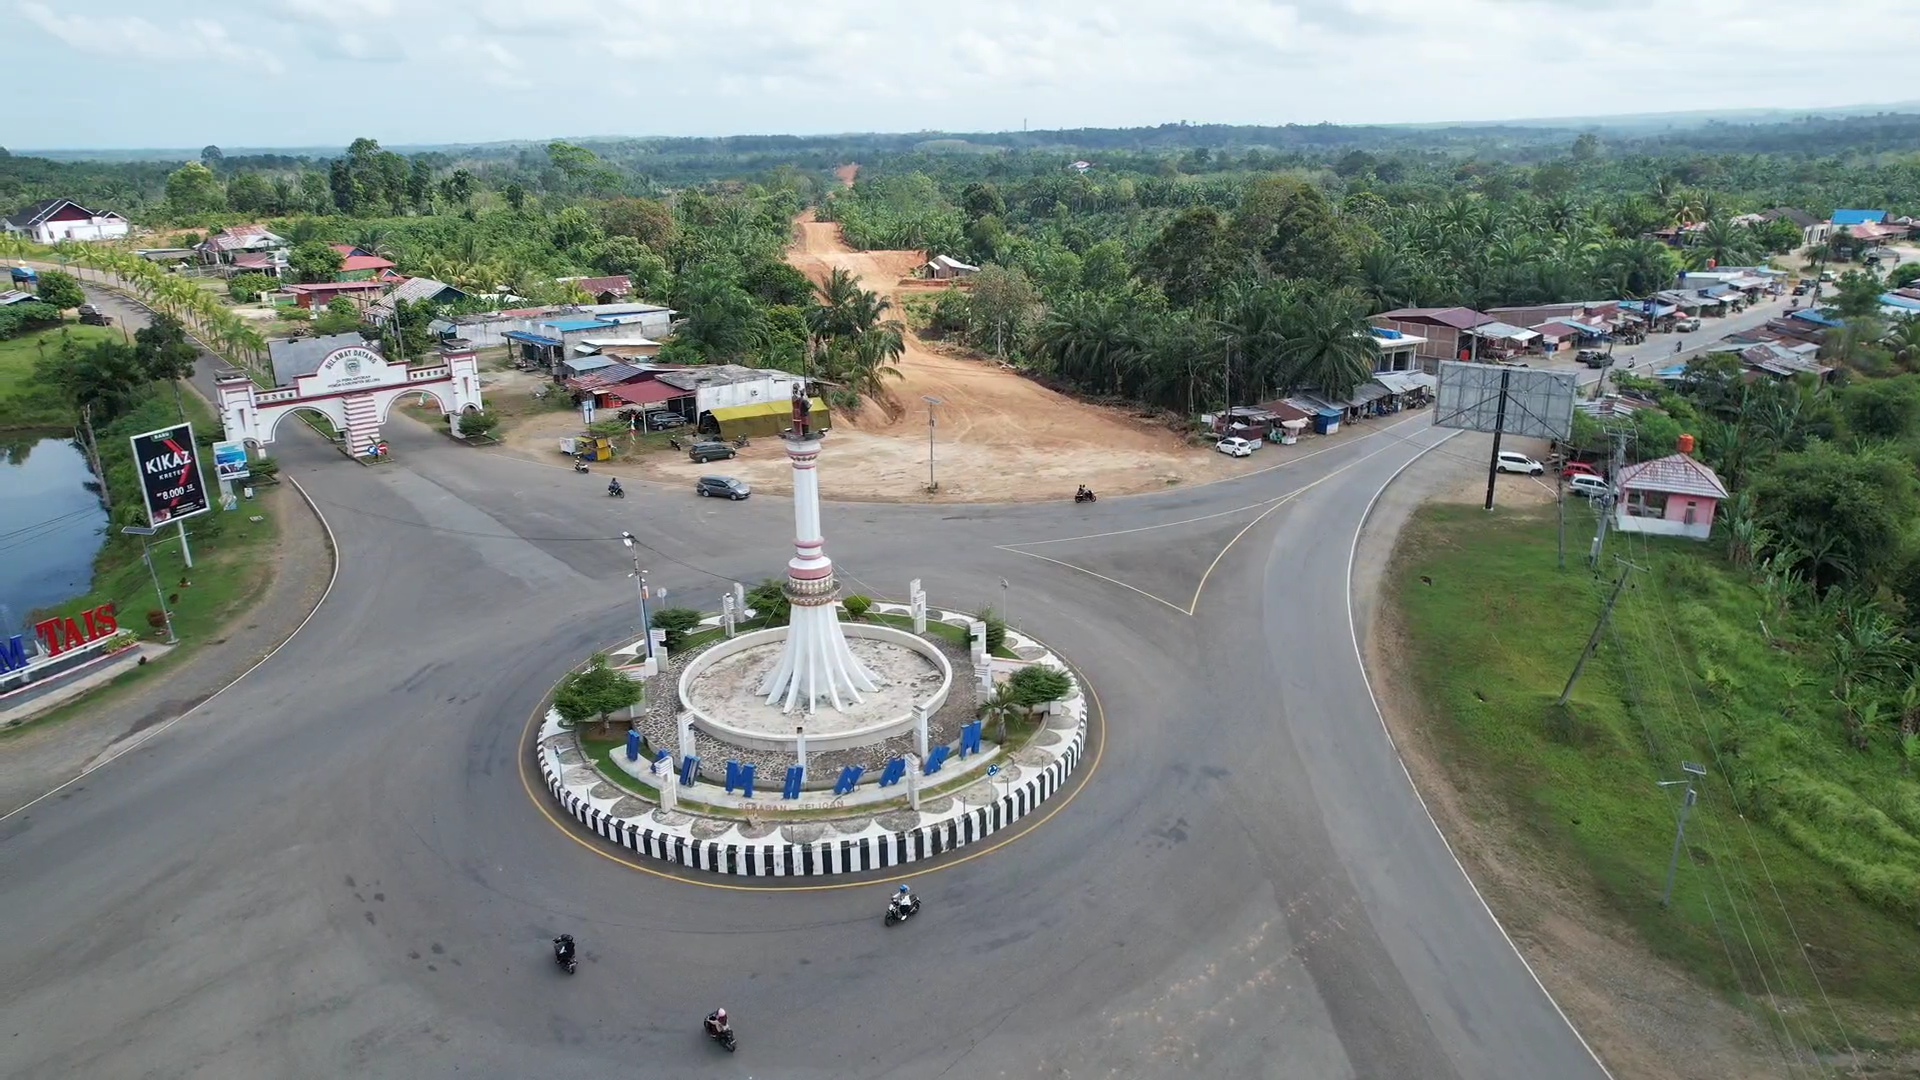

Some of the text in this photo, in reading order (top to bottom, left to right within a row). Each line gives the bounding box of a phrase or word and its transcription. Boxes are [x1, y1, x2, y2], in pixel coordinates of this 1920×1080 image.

[325, 350, 377, 370] SELAMAT DATANG
[145, 451, 192, 474] KIKAZ
[159, 468, 186, 480] KRETEK
[162, 487, 184, 500] 8.000
[35, 603, 118, 657] TAIS
